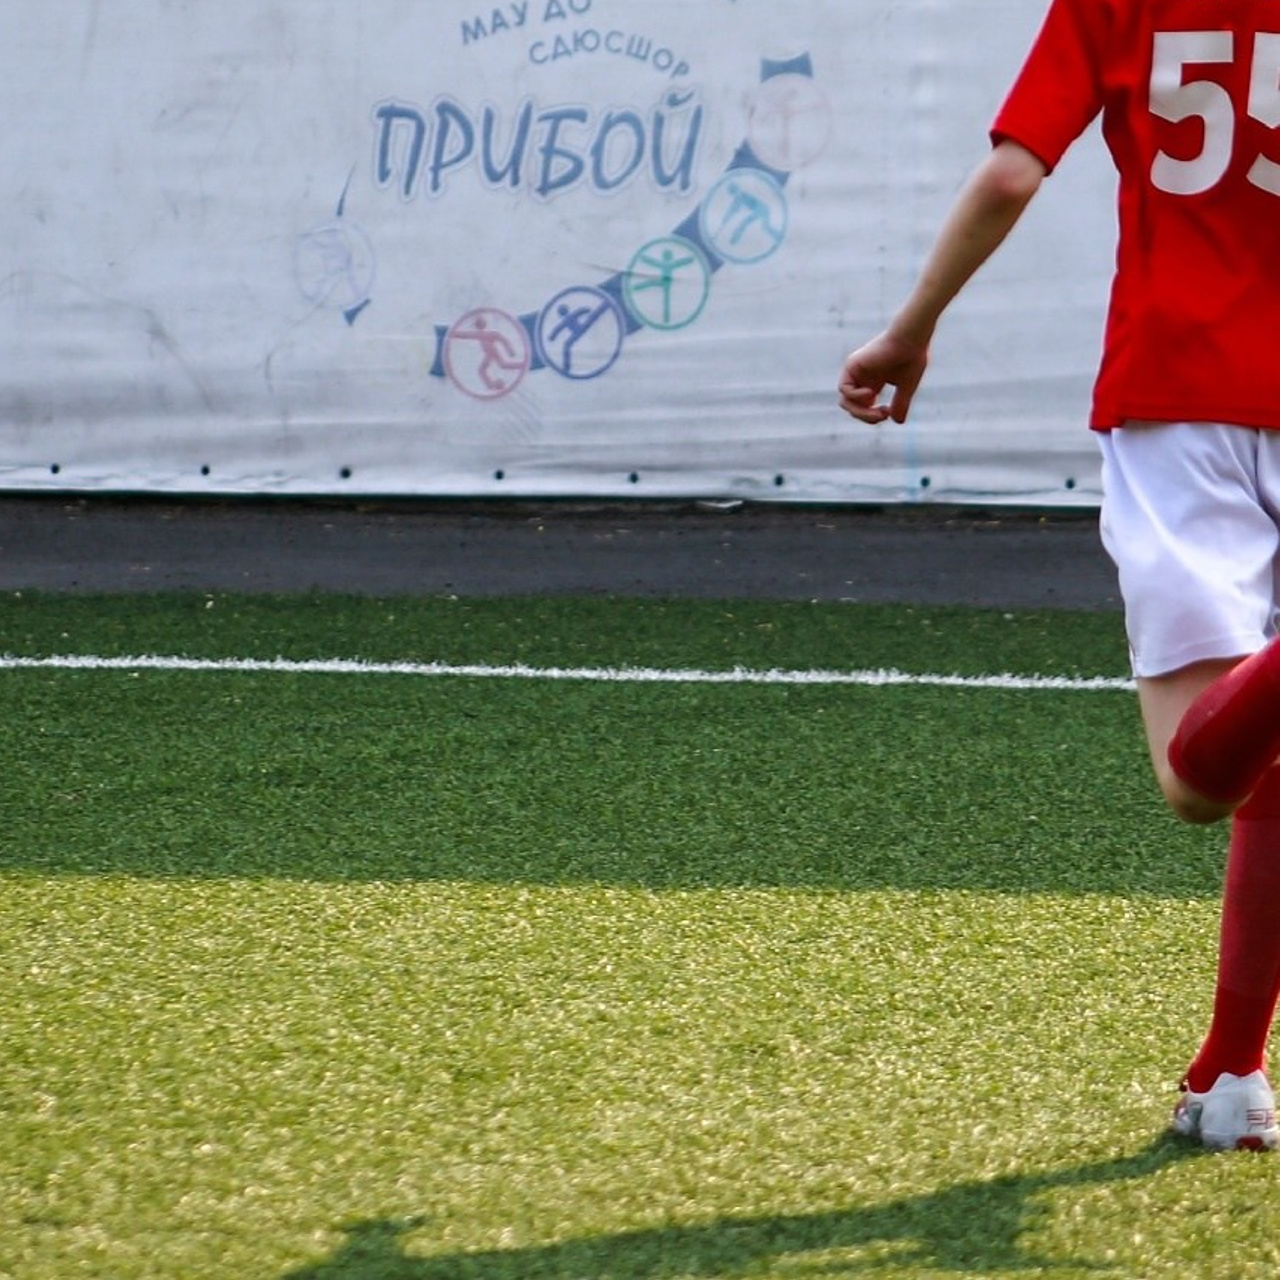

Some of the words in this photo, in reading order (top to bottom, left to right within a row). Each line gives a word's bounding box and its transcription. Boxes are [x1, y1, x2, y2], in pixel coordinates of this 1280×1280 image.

[461, 0, 528, 45] МАУ
[529, 29, 690, 78] СДЮСШОР
[376, 90, 702, 197] ПРИБОЙ
